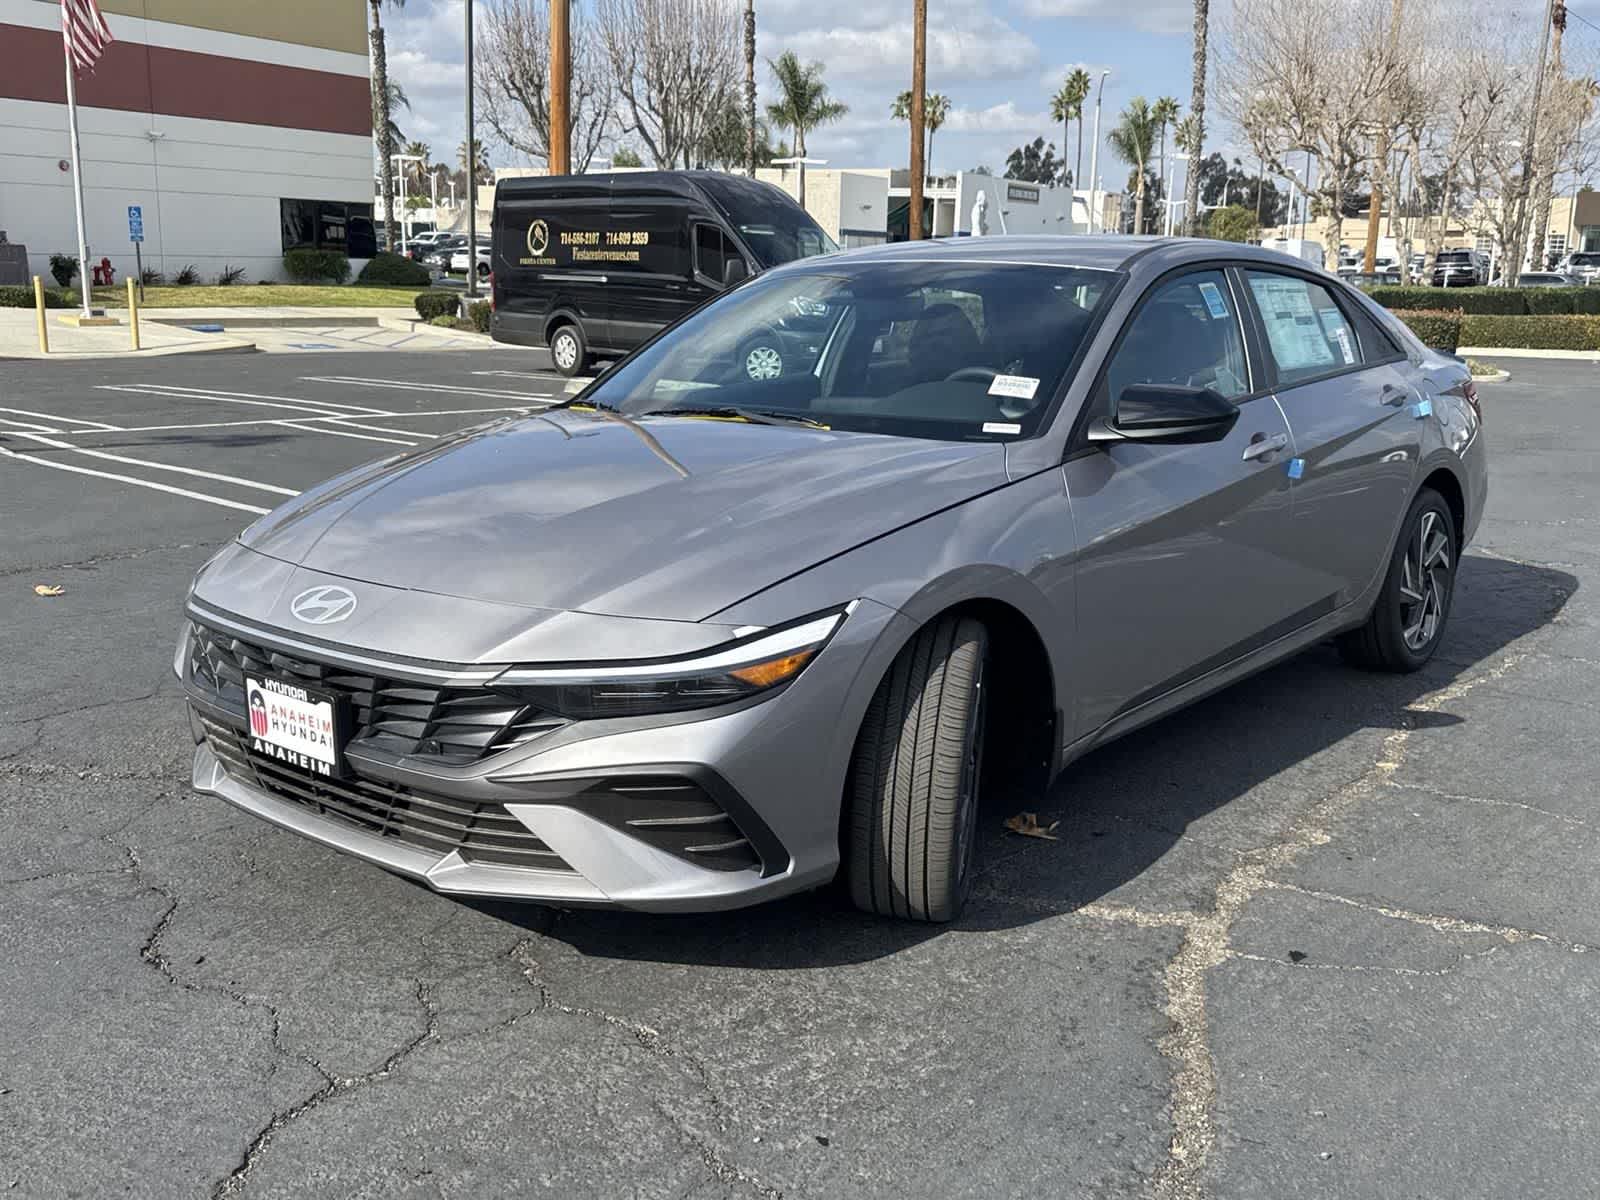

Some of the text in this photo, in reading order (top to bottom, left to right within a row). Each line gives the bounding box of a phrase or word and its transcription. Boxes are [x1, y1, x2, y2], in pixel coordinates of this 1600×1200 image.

[265, 678, 308, 702] HYUNDAI
[271, 704, 332, 733] ANAHEIM
[272, 718, 333, 748] HYUNDAI
[253, 738, 331, 776] ANAHEIM
